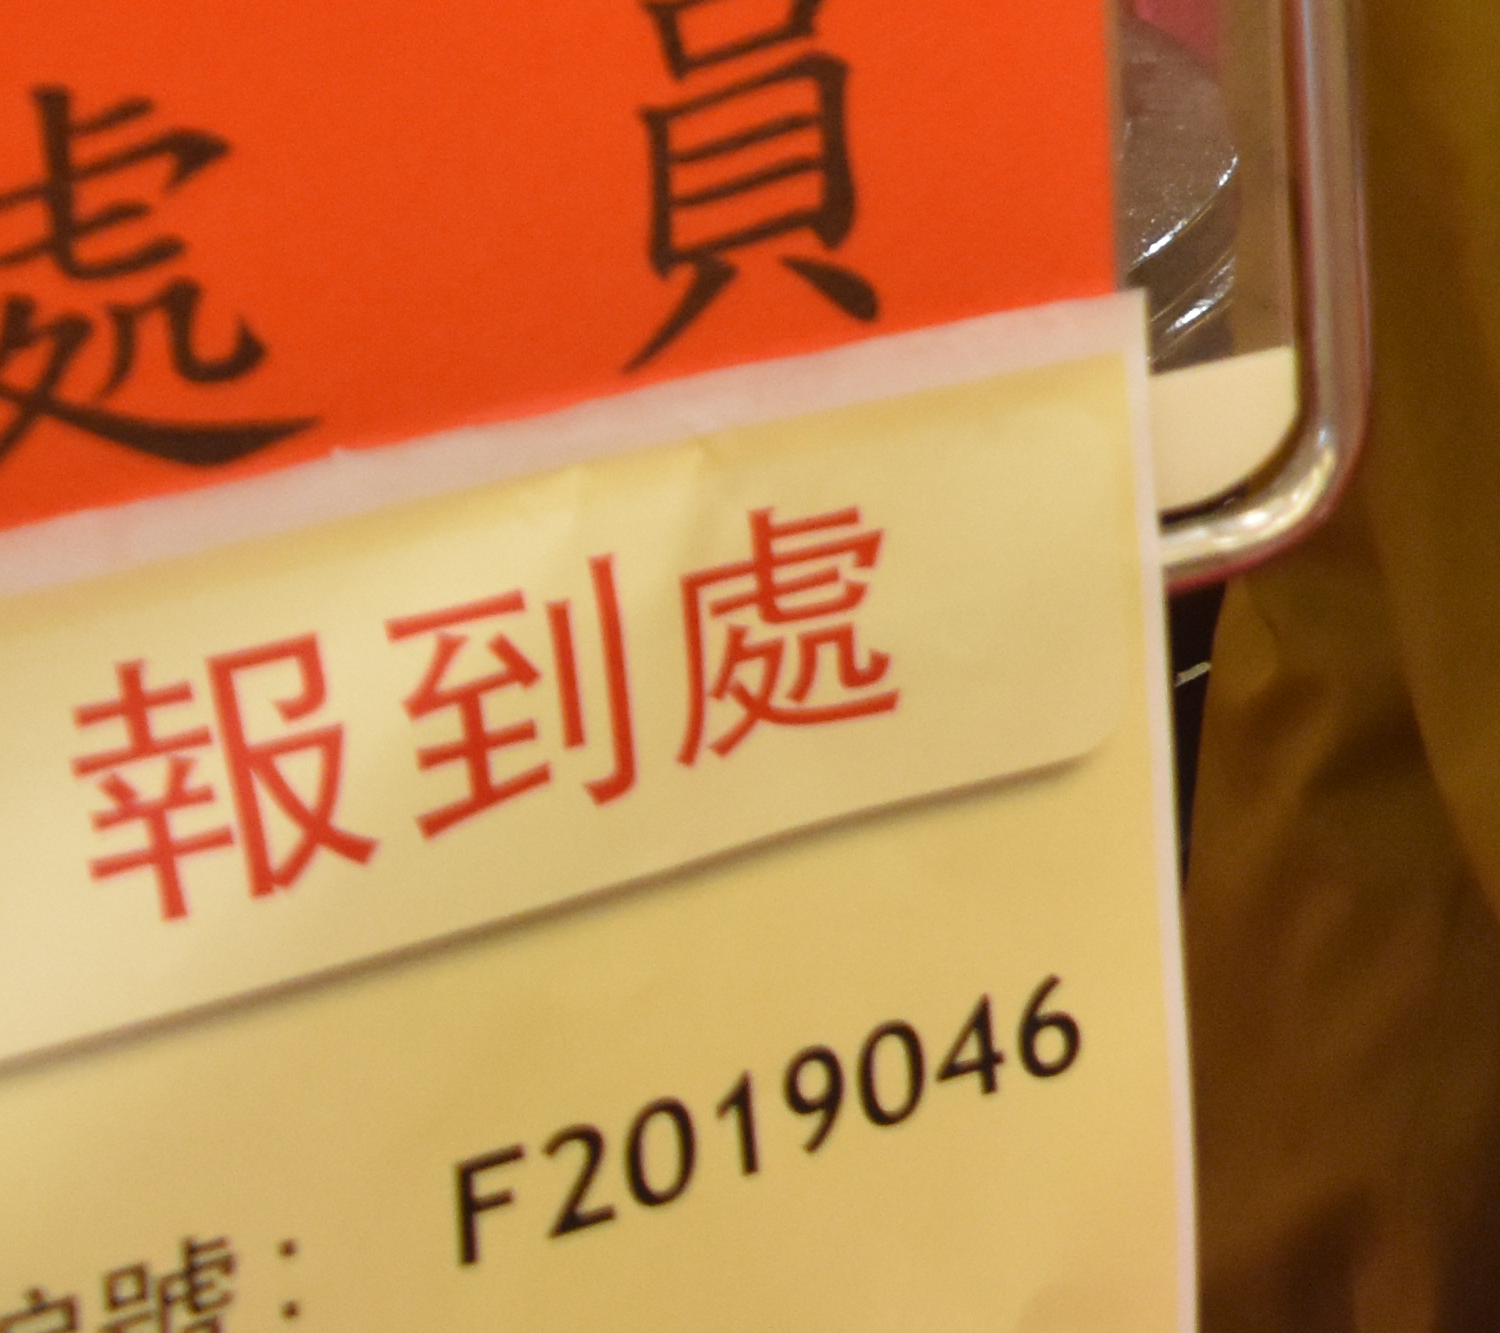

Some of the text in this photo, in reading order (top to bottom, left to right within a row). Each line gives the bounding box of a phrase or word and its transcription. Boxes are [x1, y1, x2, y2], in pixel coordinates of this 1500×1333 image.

[70, 506, 902, 923] 報到處
[453, 975, 1083, 1266] F2019046
